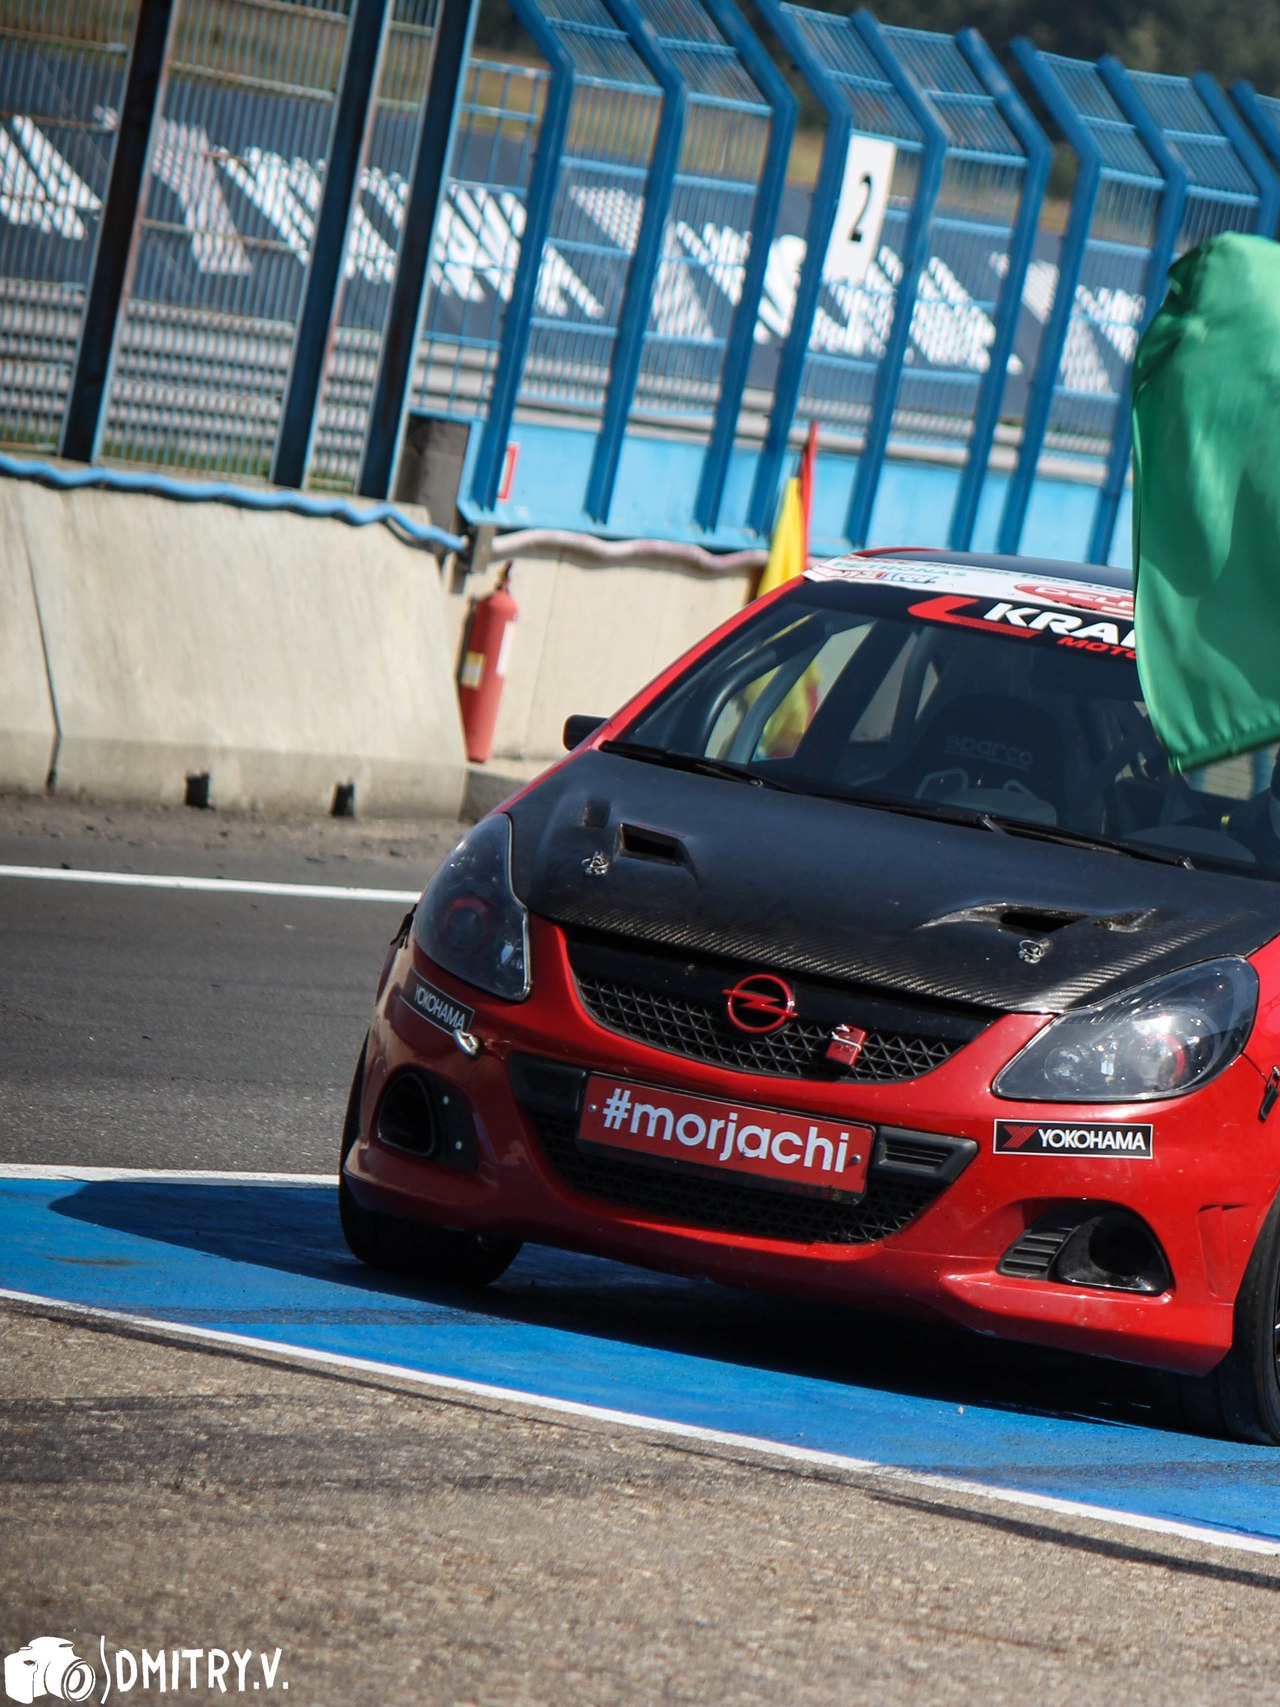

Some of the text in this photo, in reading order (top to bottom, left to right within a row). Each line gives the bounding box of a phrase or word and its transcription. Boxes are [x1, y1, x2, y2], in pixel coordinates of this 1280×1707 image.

[846, 170, 872, 243] 2
[983, 602, 1136, 649] KRA
[945, 734, 1034, 766] sparco
[413, 983, 466, 1031] YOKOHAMA
[602, 1087, 850, 1173] #morjachi
[1037, 1128, 1147, 1151] YOKOHAMA
